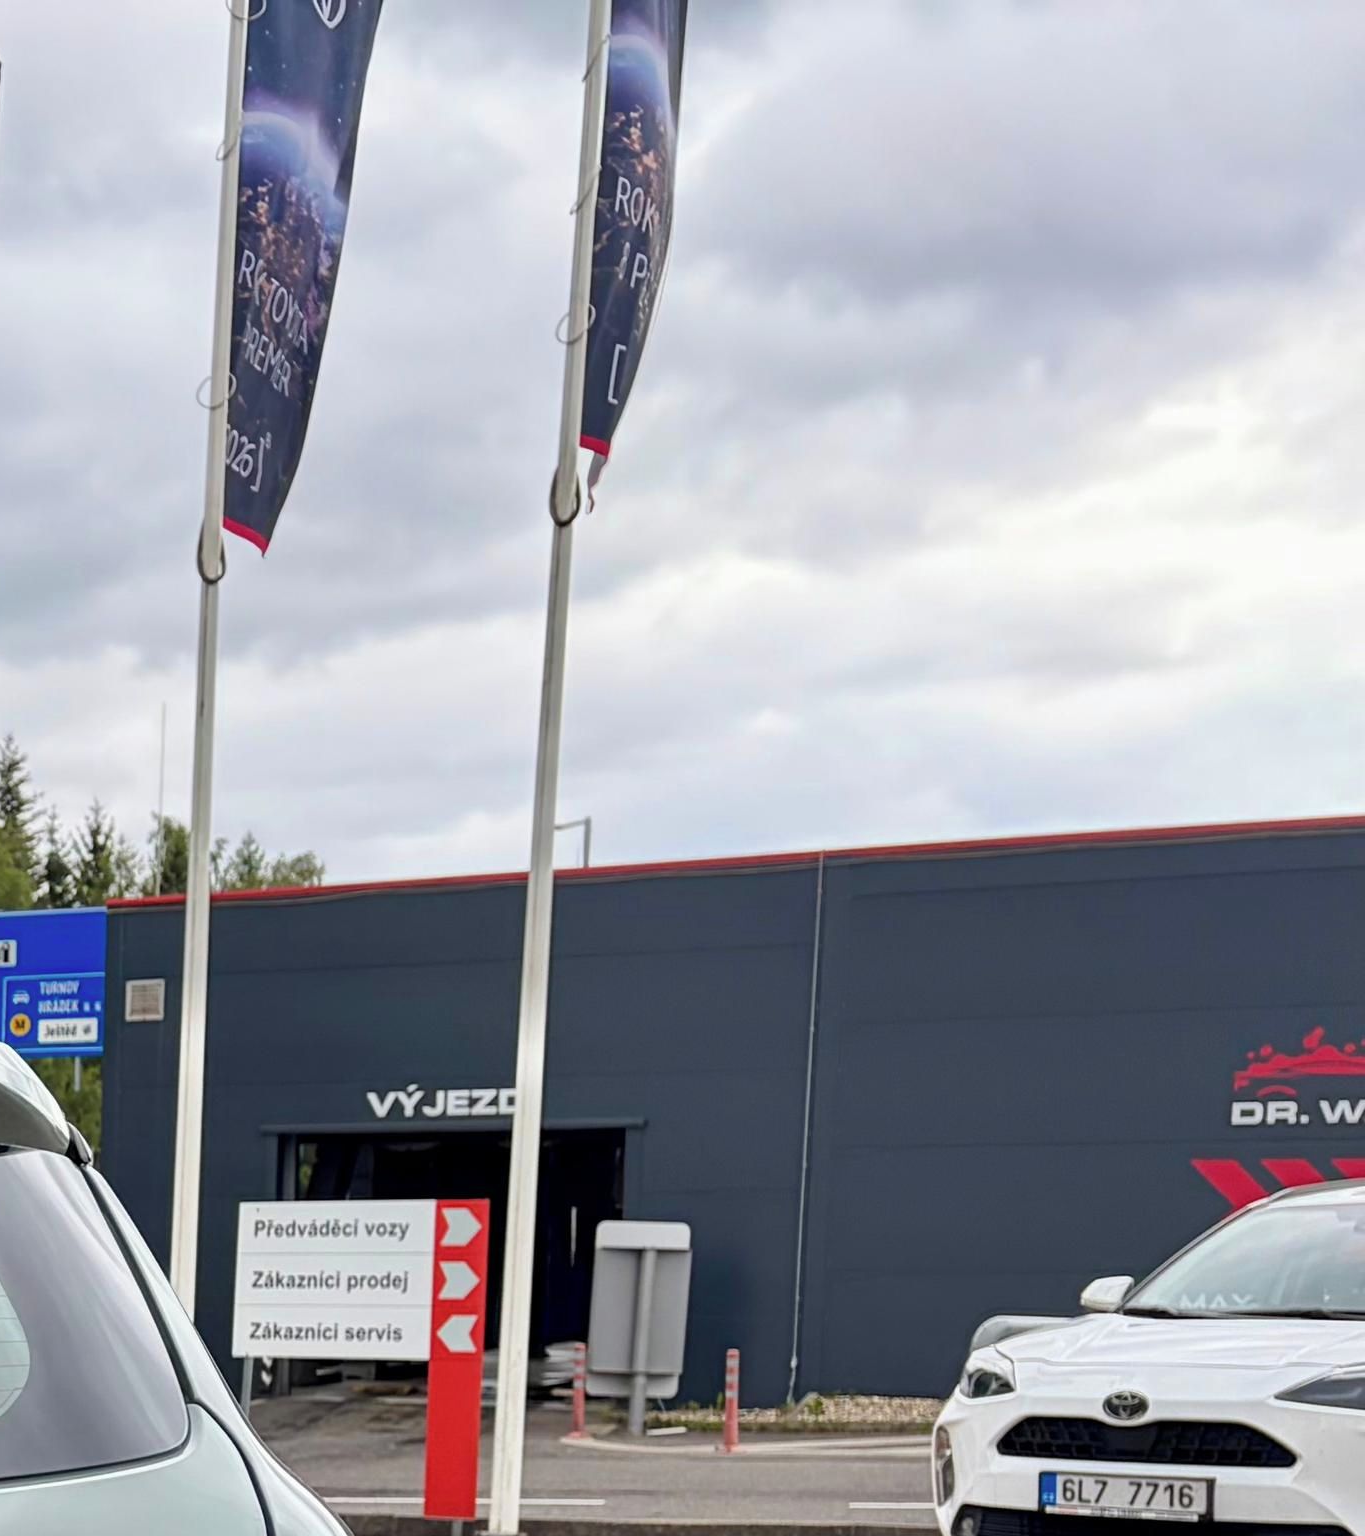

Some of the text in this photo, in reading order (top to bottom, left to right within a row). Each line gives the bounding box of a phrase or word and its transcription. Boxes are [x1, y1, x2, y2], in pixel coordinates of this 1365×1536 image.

[366, 1083, 517, 1118] VÝJEZD
[1231, 1099, 1365, 1126] DR. W
[254, 1219, 410, 1241] Předváděcí vozy
[251, 1270, 409, 1294] Zákazníci prodej
[249, 1322, 403, 1342] Zákazníci servis
[1062, 1479, 1194, 1509] 6L7 7716
